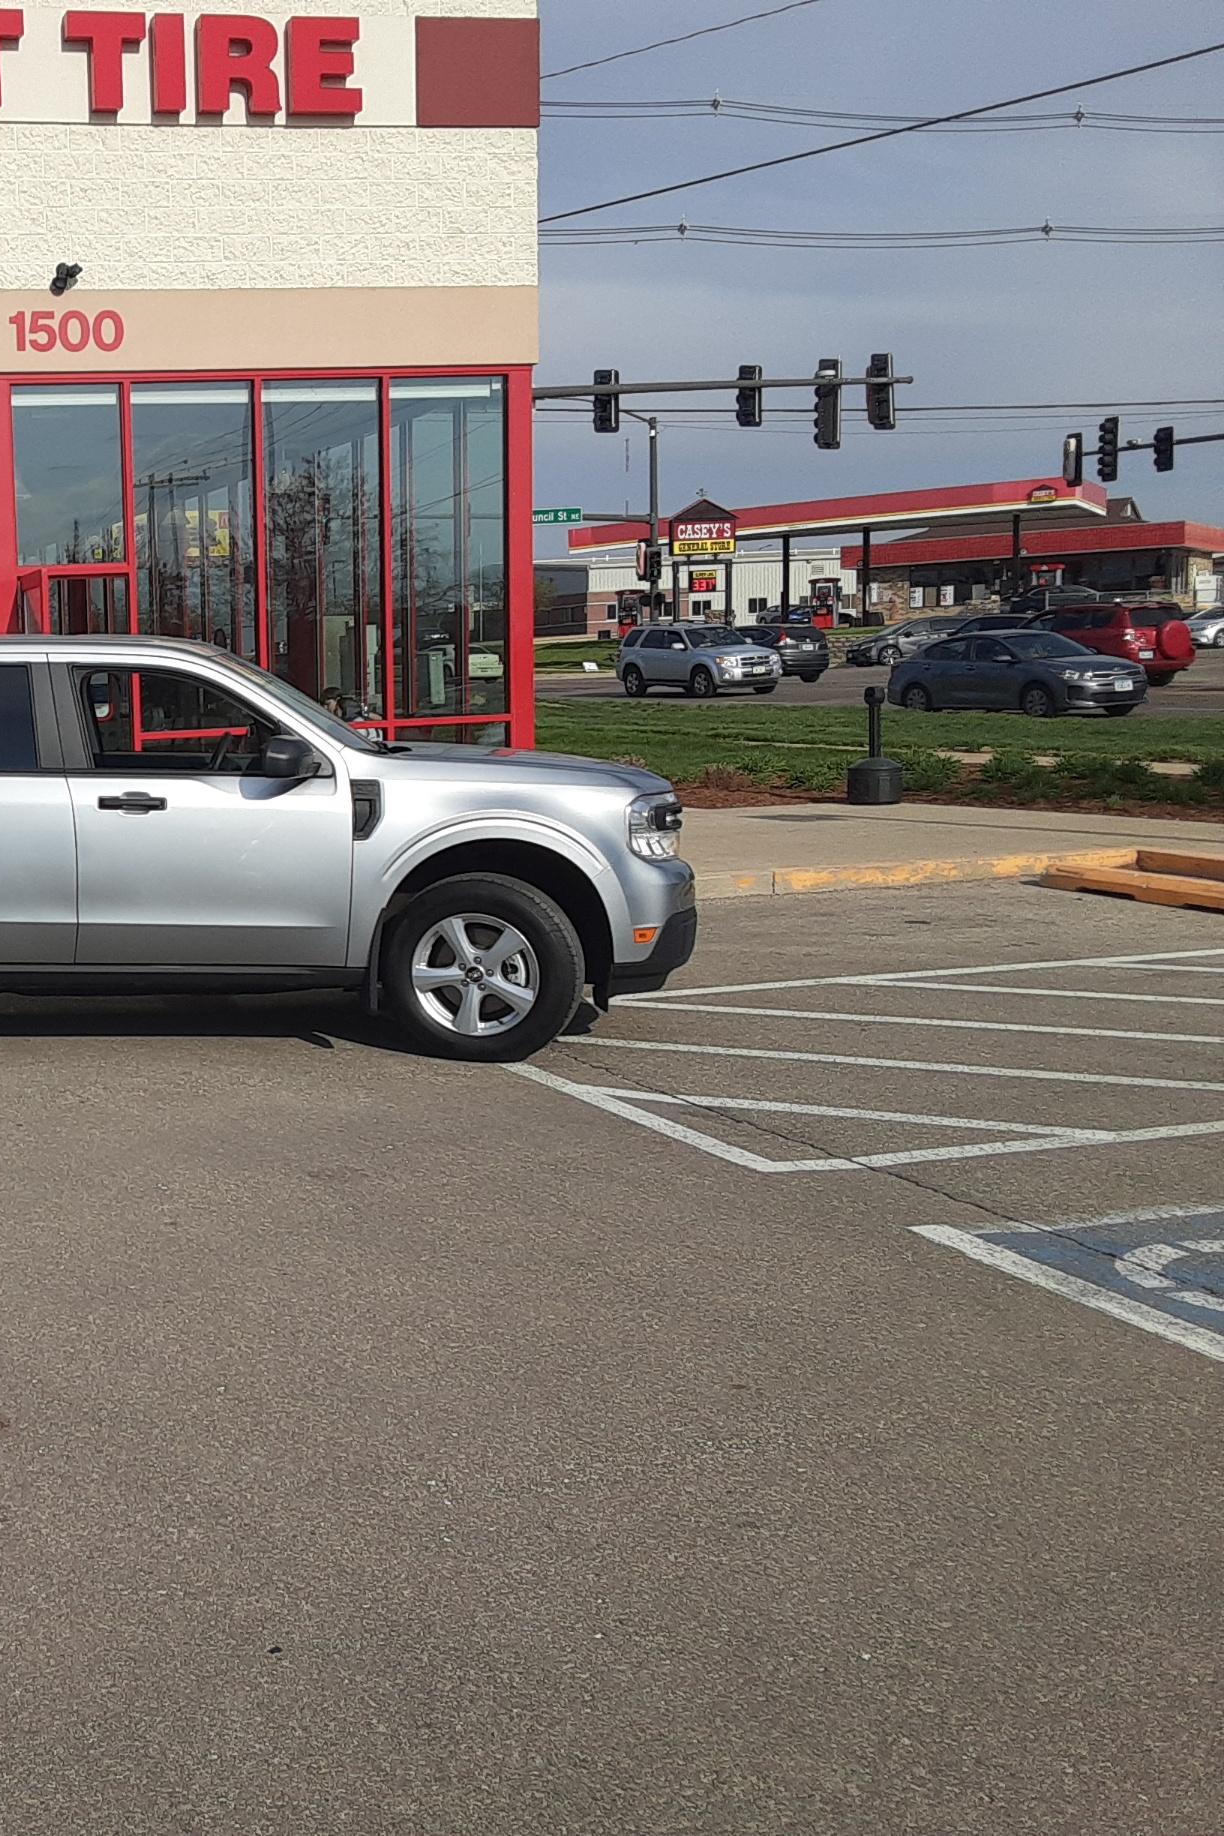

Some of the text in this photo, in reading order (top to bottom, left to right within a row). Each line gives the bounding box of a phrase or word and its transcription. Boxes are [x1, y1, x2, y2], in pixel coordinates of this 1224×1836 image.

[61, 10, 363, 116] TIRE
[8, 309, 124, 352] 1500
[533, 511, 554, 522] uncil
[557, 511, 567, 521] St
[677, 523, 731, 539] CASEY'S
[678, 541, 731, 552] GENERAL STORE
